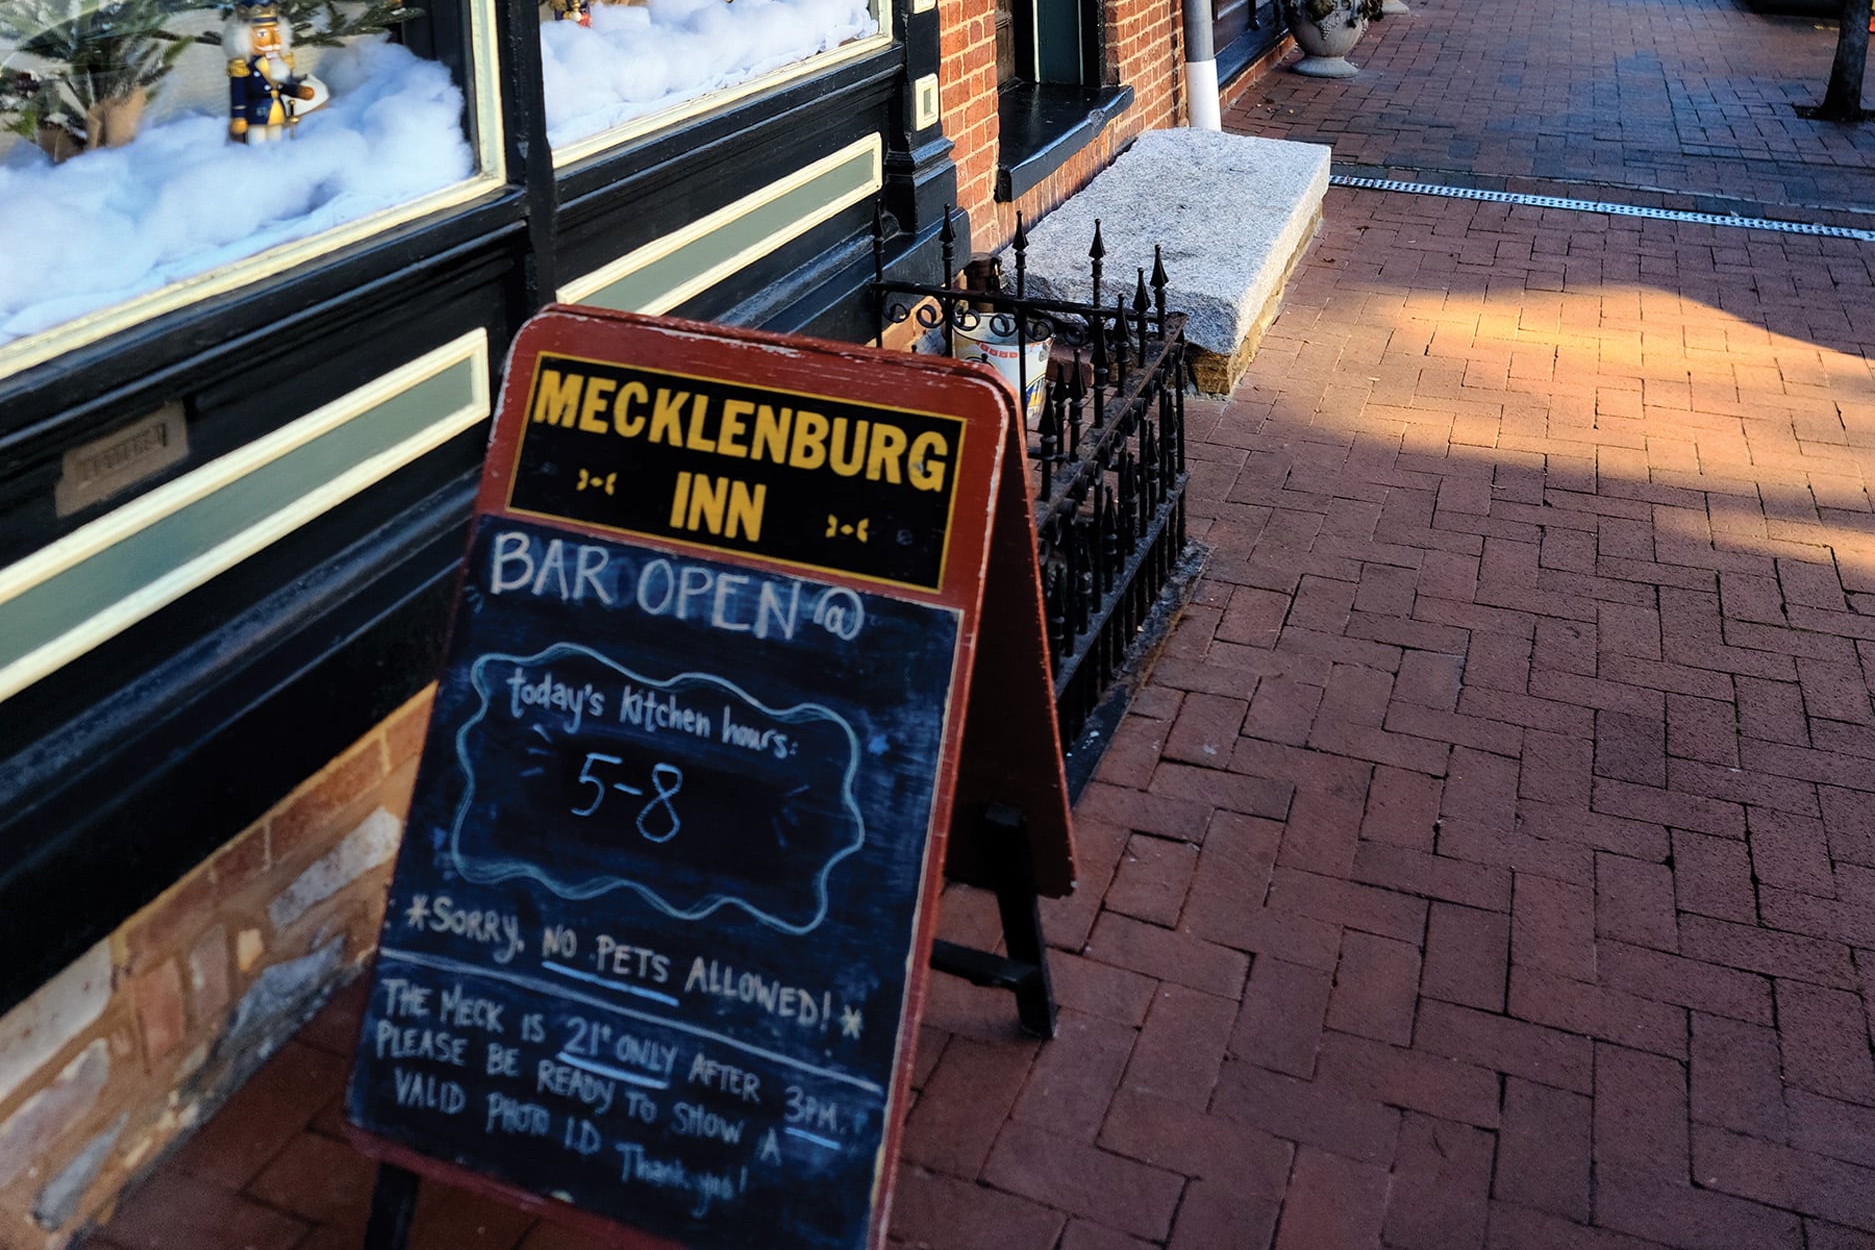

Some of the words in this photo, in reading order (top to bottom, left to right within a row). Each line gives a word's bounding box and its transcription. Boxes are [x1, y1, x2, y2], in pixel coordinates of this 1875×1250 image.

[533, 370, 949, 493] MECKLENBURG
[669, 471, 767, 543] INN
[491, 532, 613, 605] BAR
[637, 559, 802, 640] OPEN
[813, 586, 865, 641] @
[722, 704, 798, 759] hours:
[571, 753, 683, 843] 5-8
[542, 924, 578, 958] NO
[596, 934, 671, 983] PETS
[380, 978, 432, 1018] THE
[440, 982, 504, 1033] MECK
[521, 1013, 547, 1044] IS
[616, 1034, 679, 1077] ONLY
[688, 1053, 761, 1103] AFTER
[376, 1019, 468, 1066] PLEASE
[486, 1042, 520, 1077] BE
[536, 1059, 616, 1116] READY
[624, 1090, 658, 1124] TO
[671, 1102, 745, 1144] SHOW
[760, 1127, 782, 1166] A
[394, 1066, 466, 1115] VALID
